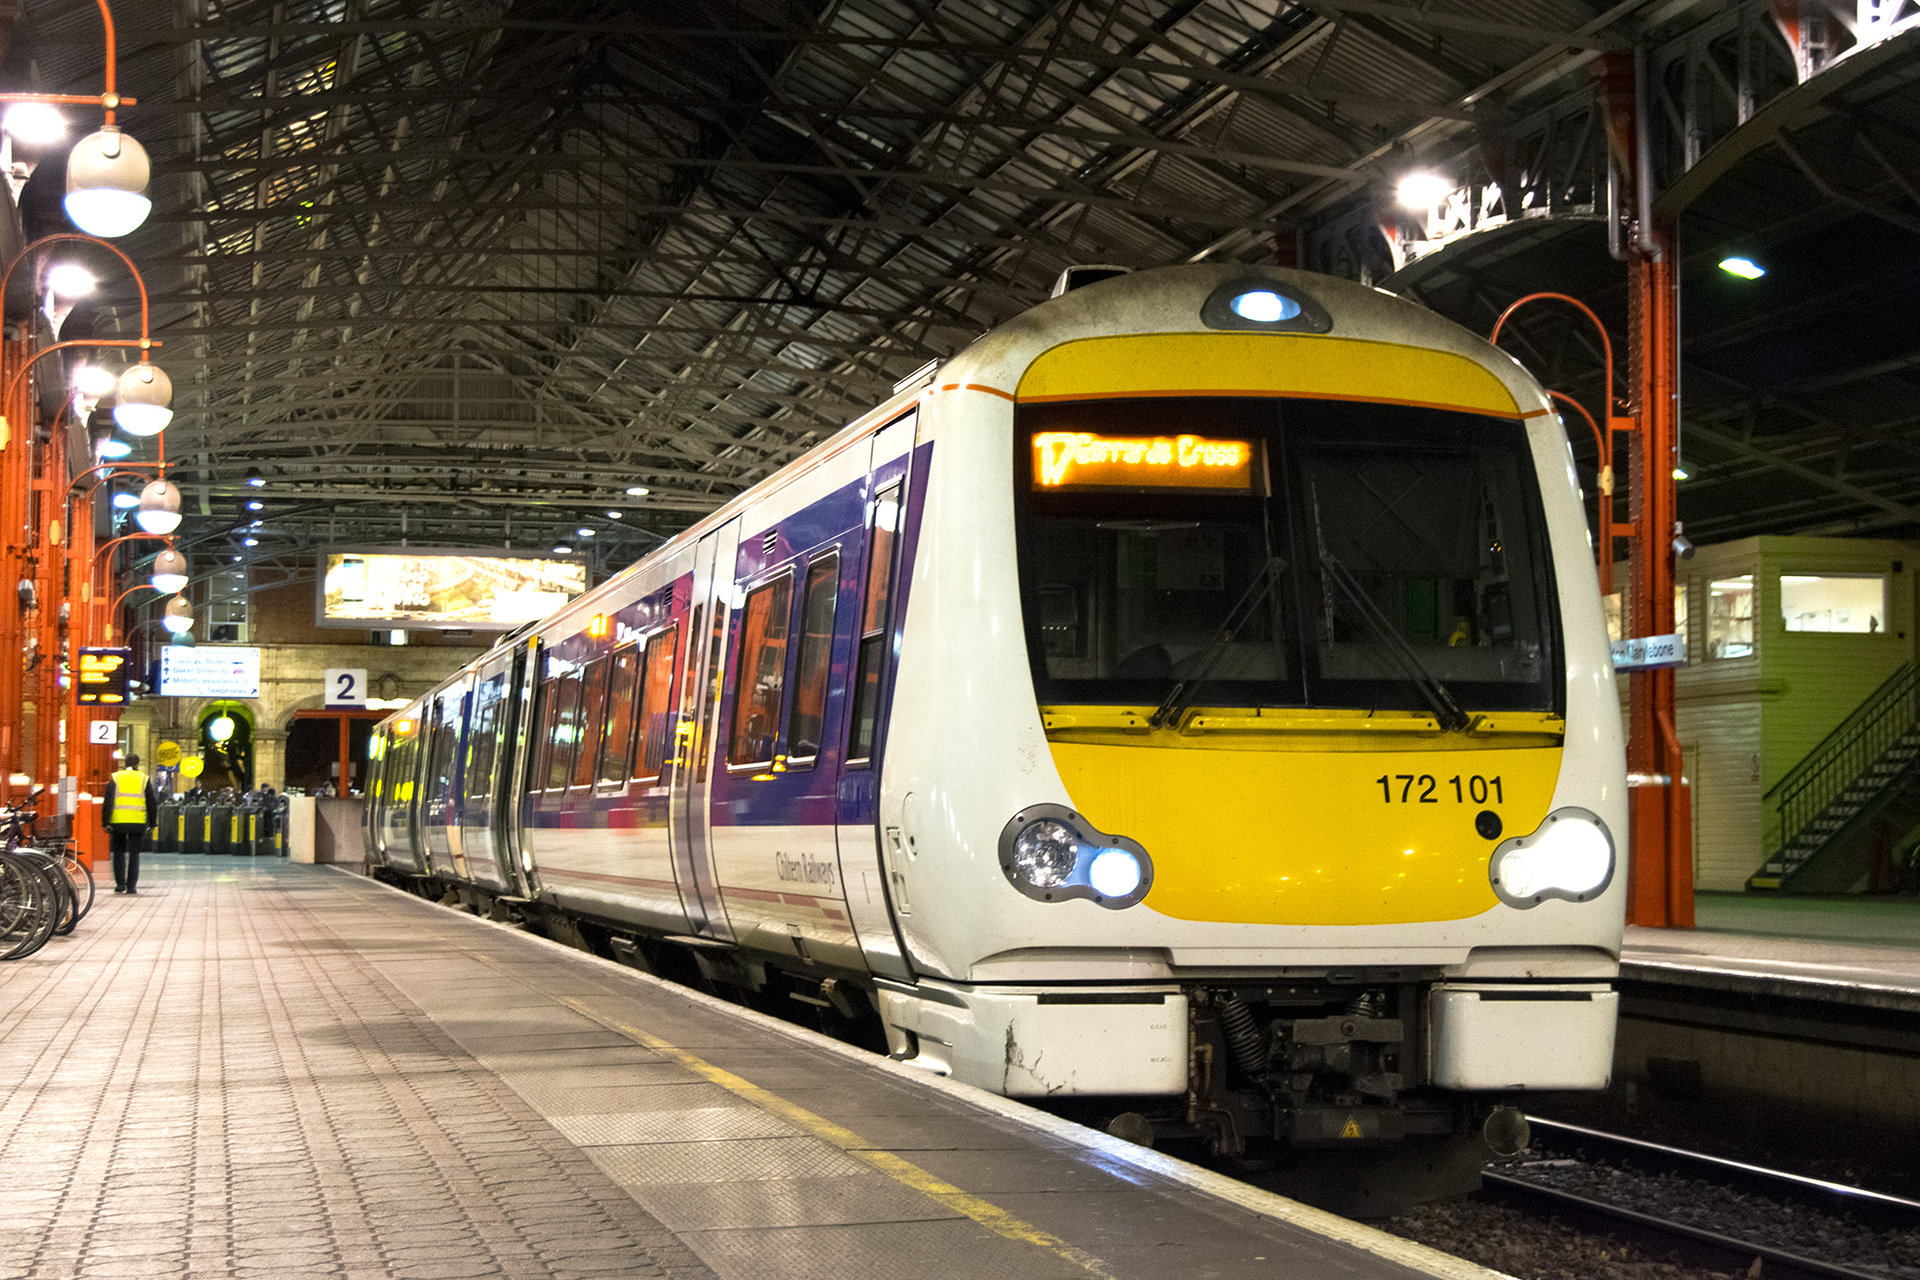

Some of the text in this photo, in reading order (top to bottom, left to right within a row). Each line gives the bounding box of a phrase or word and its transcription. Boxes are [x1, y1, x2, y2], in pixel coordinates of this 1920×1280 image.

[1177, 437, 1240, 467] Cross
[337, 673, 355, 700] 2
[98, 724, 110, 740] 2
[1376, 774, 1503, 804] 172 101
